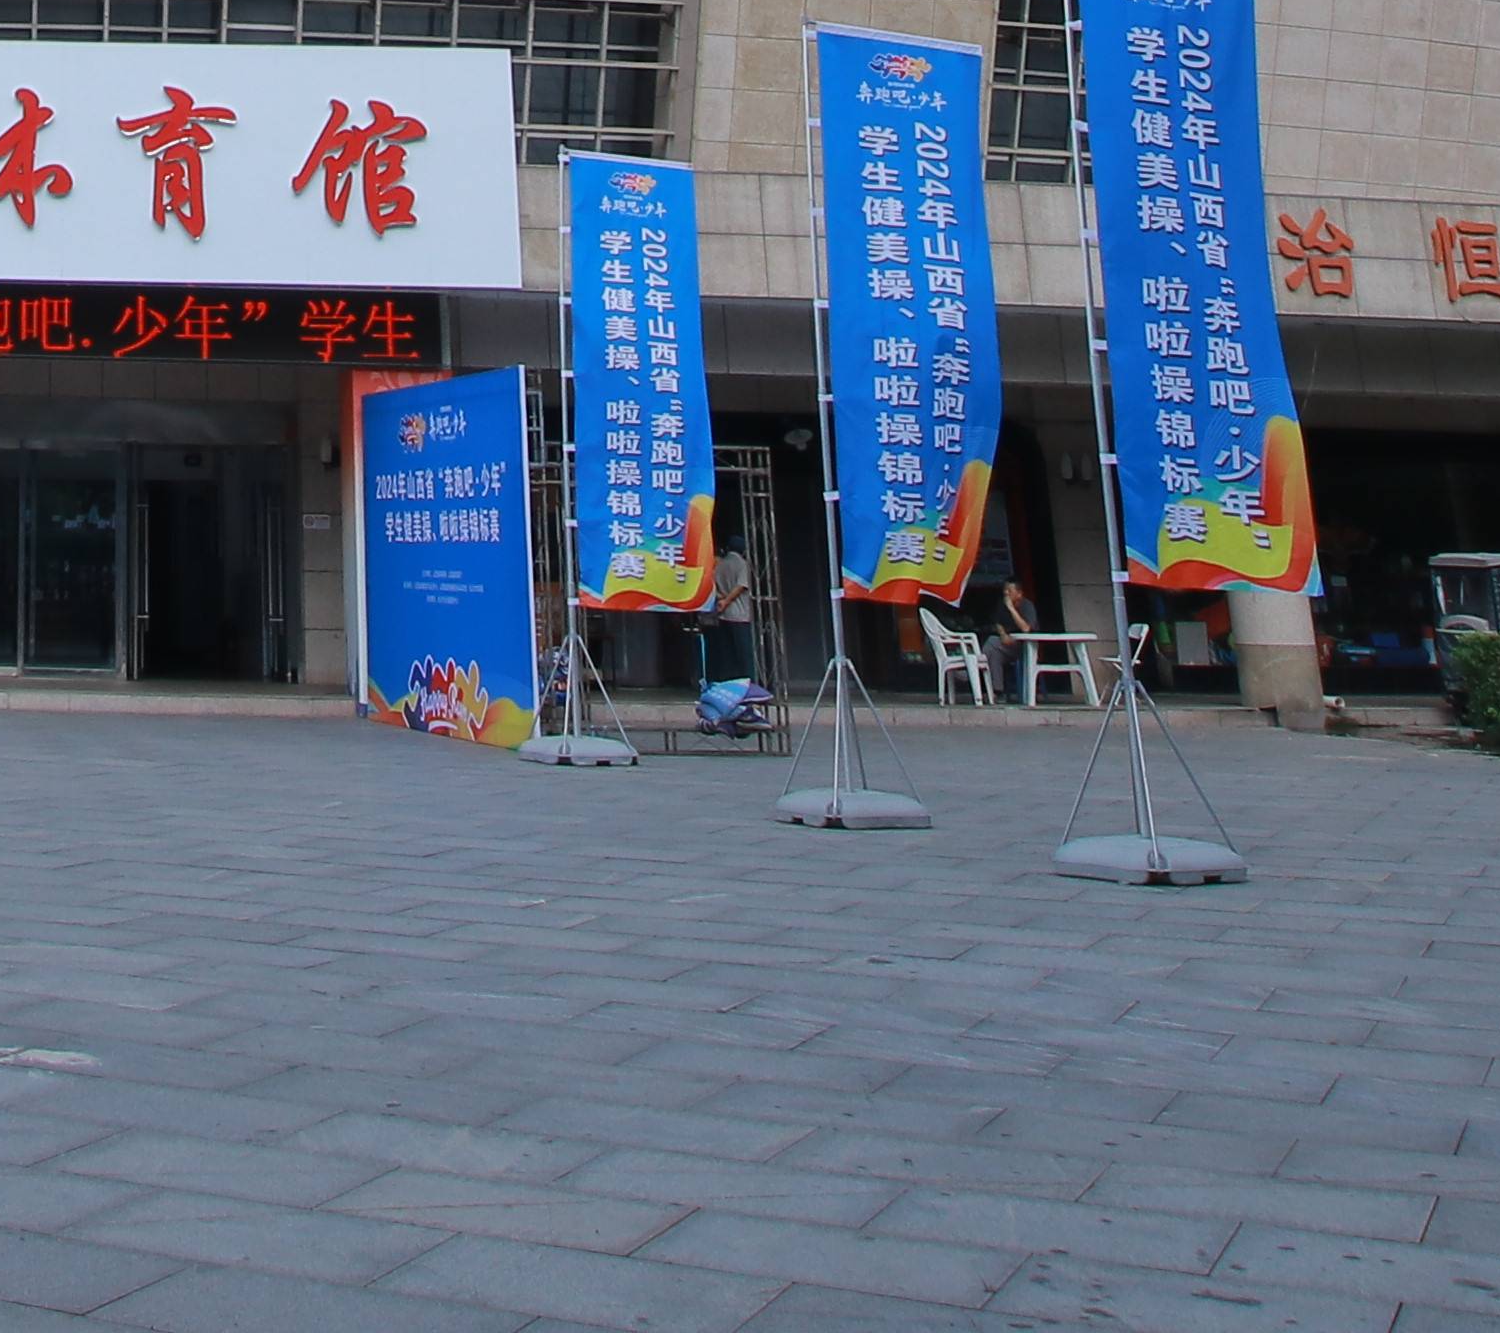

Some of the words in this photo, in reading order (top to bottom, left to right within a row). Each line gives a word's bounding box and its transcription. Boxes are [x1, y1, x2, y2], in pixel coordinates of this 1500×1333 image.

[855, 79, 948, 112] 奔跑吧·少年
[1126, 26, 1209, 544] 学生健美操、啦啦操锦标赛
[599, 230, 645, 582] 学生健美操、啦啦操锦标赛
[858, 125, 925, 566] 学生健美操、啦啦操锦标赛
